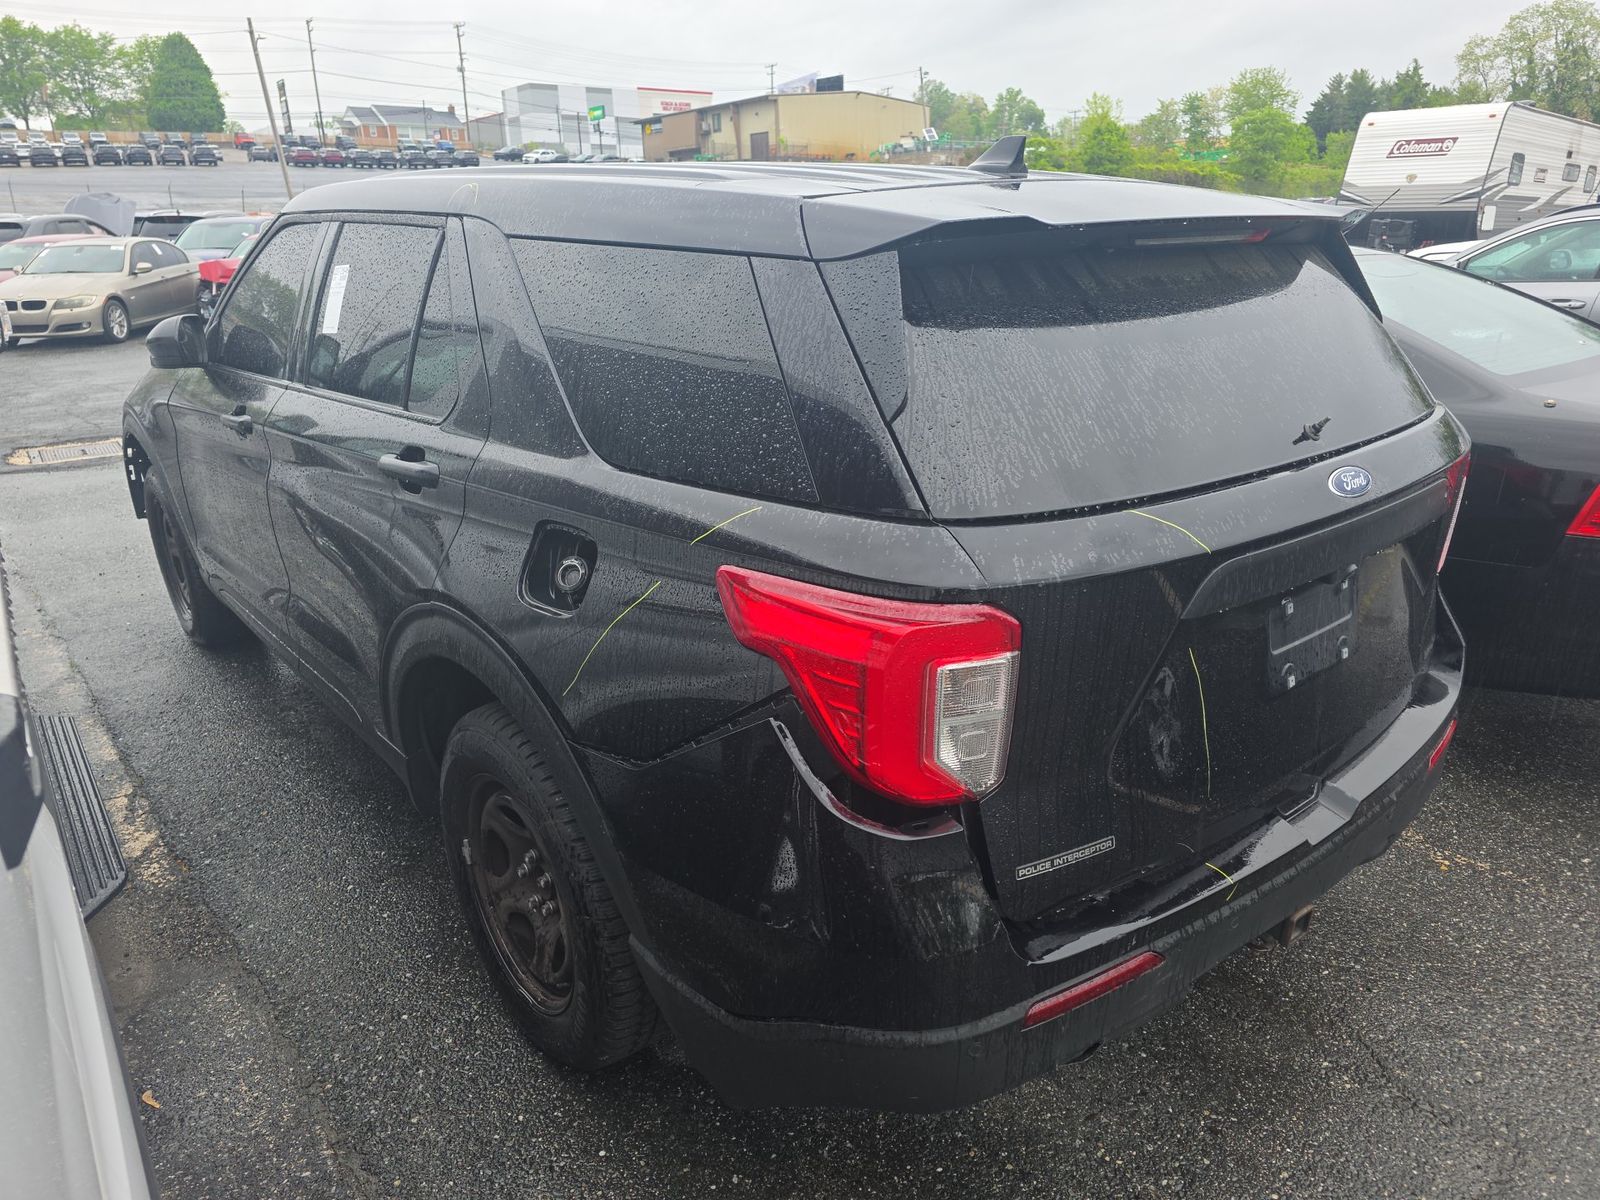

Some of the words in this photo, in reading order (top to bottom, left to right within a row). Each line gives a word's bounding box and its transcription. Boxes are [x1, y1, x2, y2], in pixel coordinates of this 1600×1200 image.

[1392, 140, 1442, 154] Coleman
[1341, 471, 1367, 491] Ford
[1018, 861, 1051, 877] POLICE
[1053, 840, 1112, 866] INTERCEPTOR
